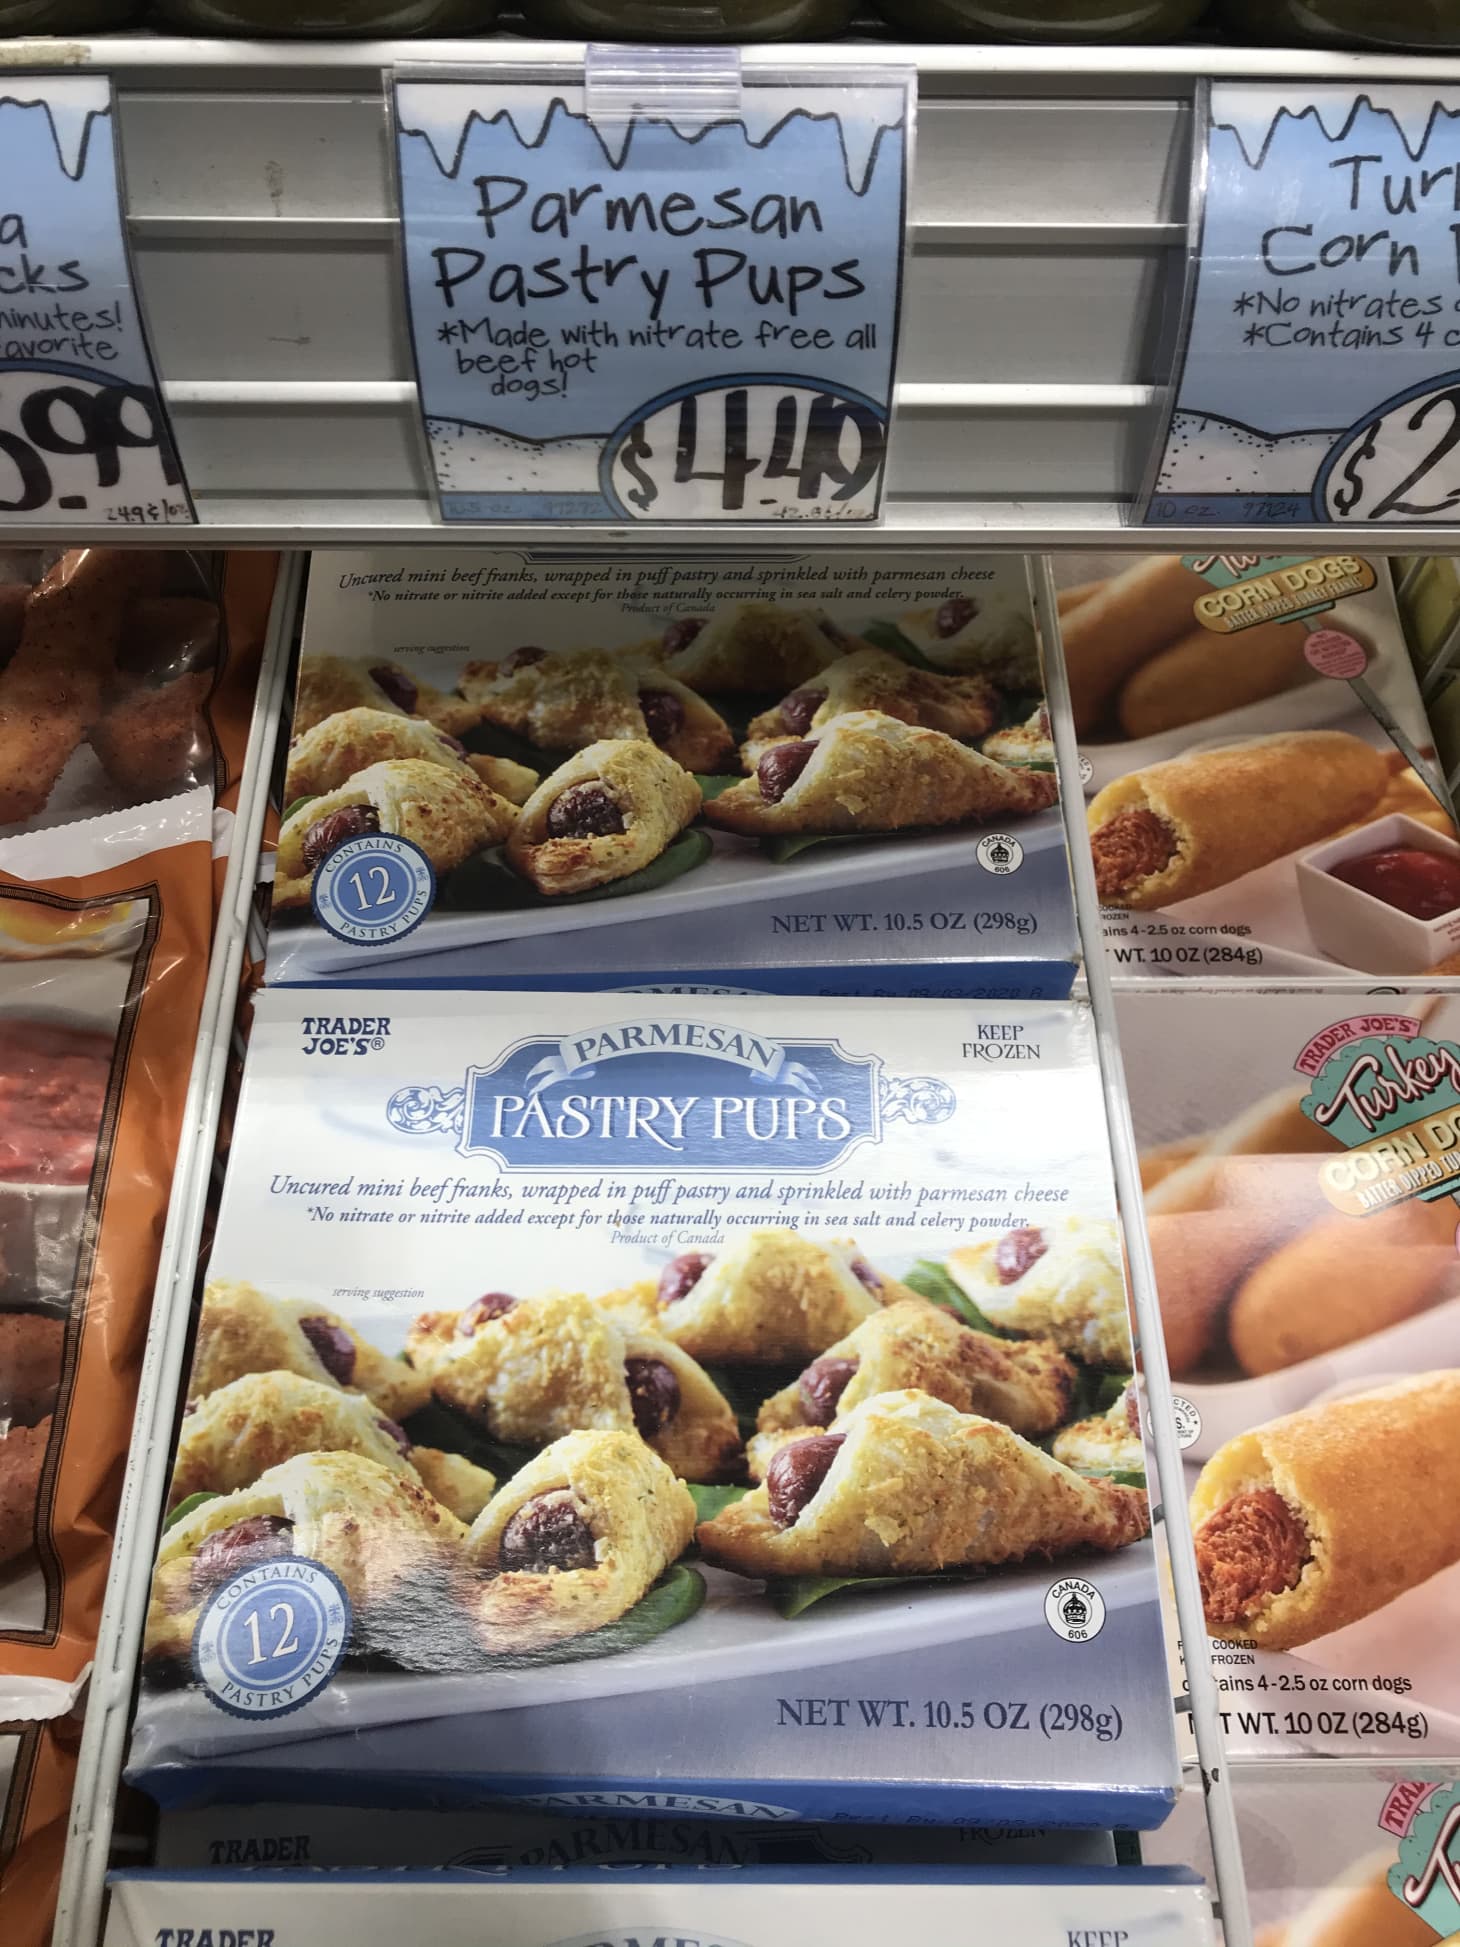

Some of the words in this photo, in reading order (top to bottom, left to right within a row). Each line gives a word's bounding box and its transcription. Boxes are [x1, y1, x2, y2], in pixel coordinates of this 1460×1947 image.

[473, 175, 823, 239] Parmesan
[1261, 223, 1420, 277] Corn
[432, 244, 670, 320] Pastry
[693, 247, 866, 316] Pups
[1310, 288, 1443, 320] nitrates
[0, 333, 119, 360] avorite
[560, 320, 619, 349] with
[629, 319, 744, 349] nitrate
[755, 322, 835, 349] free
[845, 323, 878, 350] all
[1415, 319, 1434, 347] 4
[456, 347, 536, 375] beef
[548, 347, 599, 374] hot
[490, 371, 570, 401] dogs!
[339, 568, 403, 589] Uncured
[408, 568, 447, 583] mini
[451, 567, 490, 586] beef
[485, 567, 538, 586] franks,
[545, 568, 610, 586] wrapped
[616, 568, 632, 582] in
[636, 567, 673, 586] puff
[671, 568, 719, 586] pastry
[723, 567, 753, 581] and
[758, 566, 829, 585] sprinkled
[833, 566, 868, 581] with
[873, 568, 945, 585] parmesan
[950, 567, 996, 581] cheese
[1199, 578, 1281, 617] CORN
[1280, 555, 1362, 591] DOGS
[395, 589, 438, 601] nitrate
[443, 593, 458, 601] or
[461, 589, 503, 601] nitrite
[506, 588, 548, 601] added
[550, 590, 591, 604] except
[590, 588, 614, 604] for
[616, 588, 649, 600] those
[652, 588, 712, 601] naturally
[716, 588, 776, 602] occurring
[780, 588, 793, 599] in
[797, 590, 817, 600] sea
[820, 587, 843, 600] salt
[846, 588, 872, 600] and
[875, 588, 912, 601] celery
[914, 588, 964, 602] powder.
[621, 603, 661, 614] Product
[663, 603, 675, 615] of
[676, 603, 716, 613] Canada
[981, 834, 1017, 848] CANADA
[326, 838, 405, 874] CONTAINS
[349, 866, 397, 912] 12
[340, 921, 398, 939] PASTRY
[402, 889, 428, 925] PUPS
[771, 914, 827, 934] NET
[833, 914, 878, 932] WT.
[882, 913, 924, 931] 10.5
[930, 913, 966, 931] OZ
[973, 912, 1037, 935] (298g)
[1171, 927, 1185, 935] oz
[1189, 926, 1218, 935] corn
[1220, 924, 1252, 937] dogs
[1114, 947, 1145, 963] WT.
[1150, 947, 1172, 963] 10
[1176, 947, 1200, 963] OZ
[1203, 946, 1263, 966] (284g)
[301, 1017, 391, 1035] TRADER
[976, 1024, 1024, 1040] KEEP
[573, 1022, 779, 1068] PARMESAN
[962, 1043, 1041, 1063] FROZEN
[1300, 1023, 1357, 1071] TRADER
[1314, 1044, 1460, 1133] Turkey
[489, 1093, 698, 1151] PASTRY
[712, 1096, 852, 1142] PUPS
[1325, 1131, 1429, 1191] CORN
[269, 1175, 351, 1197] Uncured
[357, 1178, 404, 1198] mini
[409, 1178, 456, 1205] beef
[450, 1178, 514, 1204] franks,
[521, 1179, 600, 1205] wrapped
[607, 1181, 626, 1198] in
[631, 1178, 676, 1205] puff
[674, 1180, 730, 1205] pastry
[735, 1180, 772, 1199] and
[777, 1180, 863, 1206] sprinkled
[869, 1180, 912, 1200] with
[915, 1182, 1008, 1207] parmesan
[1014, 1182, 1069, 1202] cheese
[1357, 1178, 1402, 1209] BATTER
[1399, 1161, 1443, 1191] DIPPED
[339, 1207, 394, 1223] nitrate
[398, 1212, 415, 1223] or
[420, 1207, 470, 1224] nitrite
[474, 1207, 523, 1225] added
[527, 1210, 575, 1229] except
[575, 1209, 602, 1230] for
[607, 1209, 645, 1226] those
[649, 1209, 721, 1229] naturally
[726, 1211, 799, 1230] occurring
[804, 1211, 820, 1226] in
[824, 1214, 848, 1227] sea
[852, 1210, 880, 1227] salt
[885, 1211, 915, 1228] and
[920, 1211, 964, 1231] celery
[968, 1212, 1030, 1232] powder.
[610, 1231, 658, 1245] Product
[661, 1231, 676, 1246] of
[677, 1231, 725, 1245] Canada
[332, 1287, 369, 1300] serving
[372, 1287, 424, 1300] suggestion
[214, 1566, 320, 1610] CONTAINS
[1052, 1582, 1096, 1600] CANADA
[243, 1602, 299, 1666] 12
[1067, 1629, 1088, 1640] 606
[1212, 1639, 1258, 1651] COOKED
[221, 1682, 294, 1707] PASTRY
[302, 1637, 339, 1687] PUPS
[1211, 1654, 1255, 1665] FROZEN
[1309, 1678, 1329, 1691] oz
[1332, 1677, 1368, 1691] corn
[1372, 1675, 1413, 1694] dogs
[777, 1699, 850, 1727] NET
[857, 1700, 916, 1728] WT.
[924, 1702, 975, 1729] 10.5
[984, 1702, 1030, 1731] OZ
[1039, 1704, 1123, 1742] (298g)
[1237, 1712, 1279, 1735] WT.
[1285, 1712, 1312, 1735] 10
[1317, 1712, 1348, 1735] OZ
[1352, 1711, 1429, 1738] (284g)
[208, 1835, 311, 1864] TRADER
